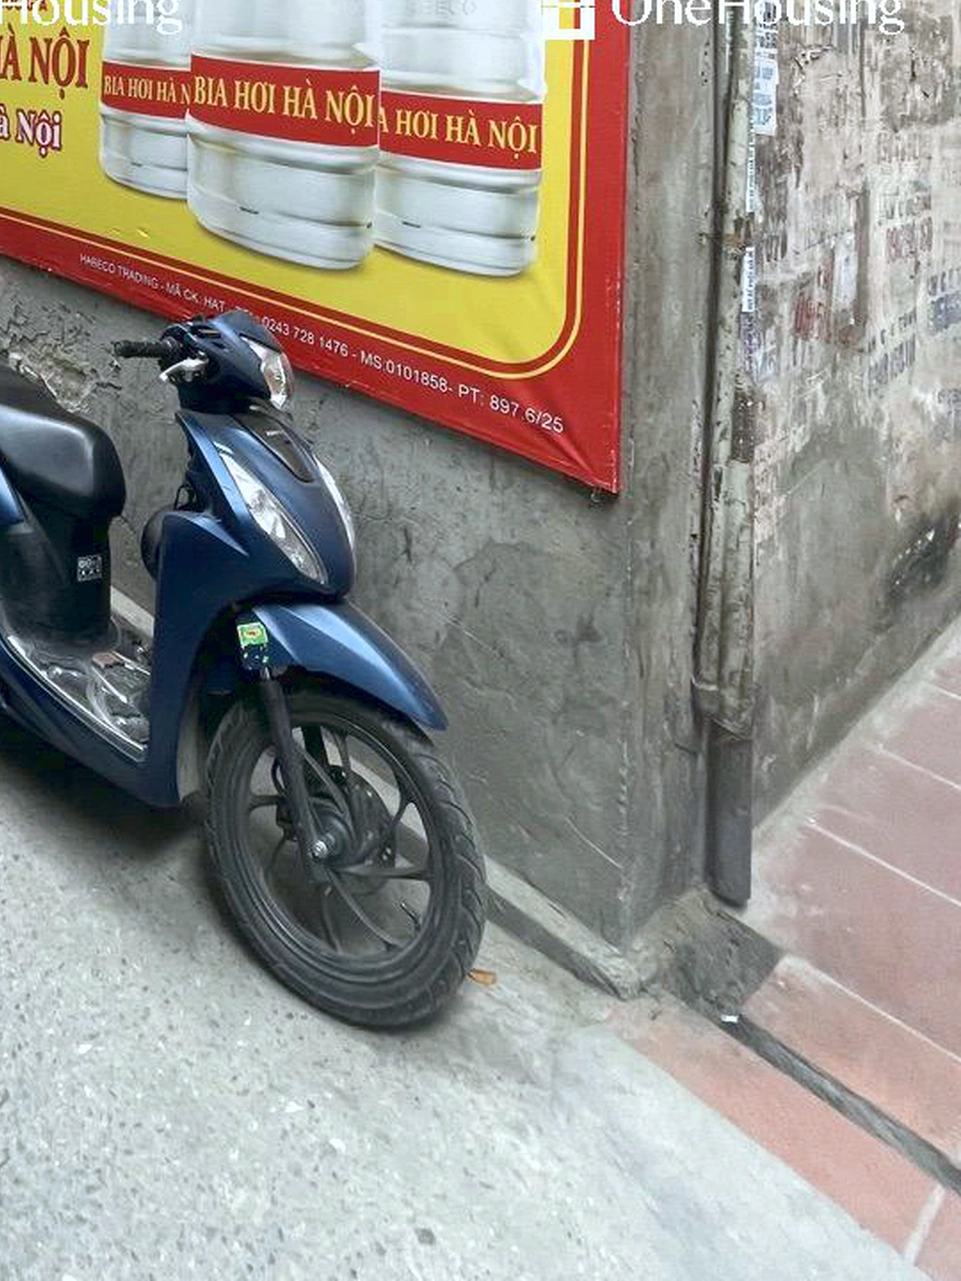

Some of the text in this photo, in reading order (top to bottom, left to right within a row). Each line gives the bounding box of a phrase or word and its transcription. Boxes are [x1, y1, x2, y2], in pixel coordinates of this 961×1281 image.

[28, 27, 91, 100] NỘI
[104, 75, 125, 97] BIA
[128, 78, 153, 101] HƠI
[156, 77, 177, 104] HÀ
[15, 110, 62, 158] Nội
[194, 76, 228, 108] BIA
[233, 80, 276, 114] HƠI
[283, 78, 318, 120] HÀ
[325, 85, 375, 135] NỘI
[395, 108, 439, 141] HƠI
[444, 109, 481, 147] HÀ
[488, 115, 539, 160] NỘI
[80, 254, 115, 275] HABECO
[117, 263, 159, 290] TRADING
[204, 296, 225, 313] HAT
[261, 316, 290, 336] 0243
[293, 326, 315, 345] 728
[319, 336, 349, 358] 1476
[458, 383, 485, 406] PT:
